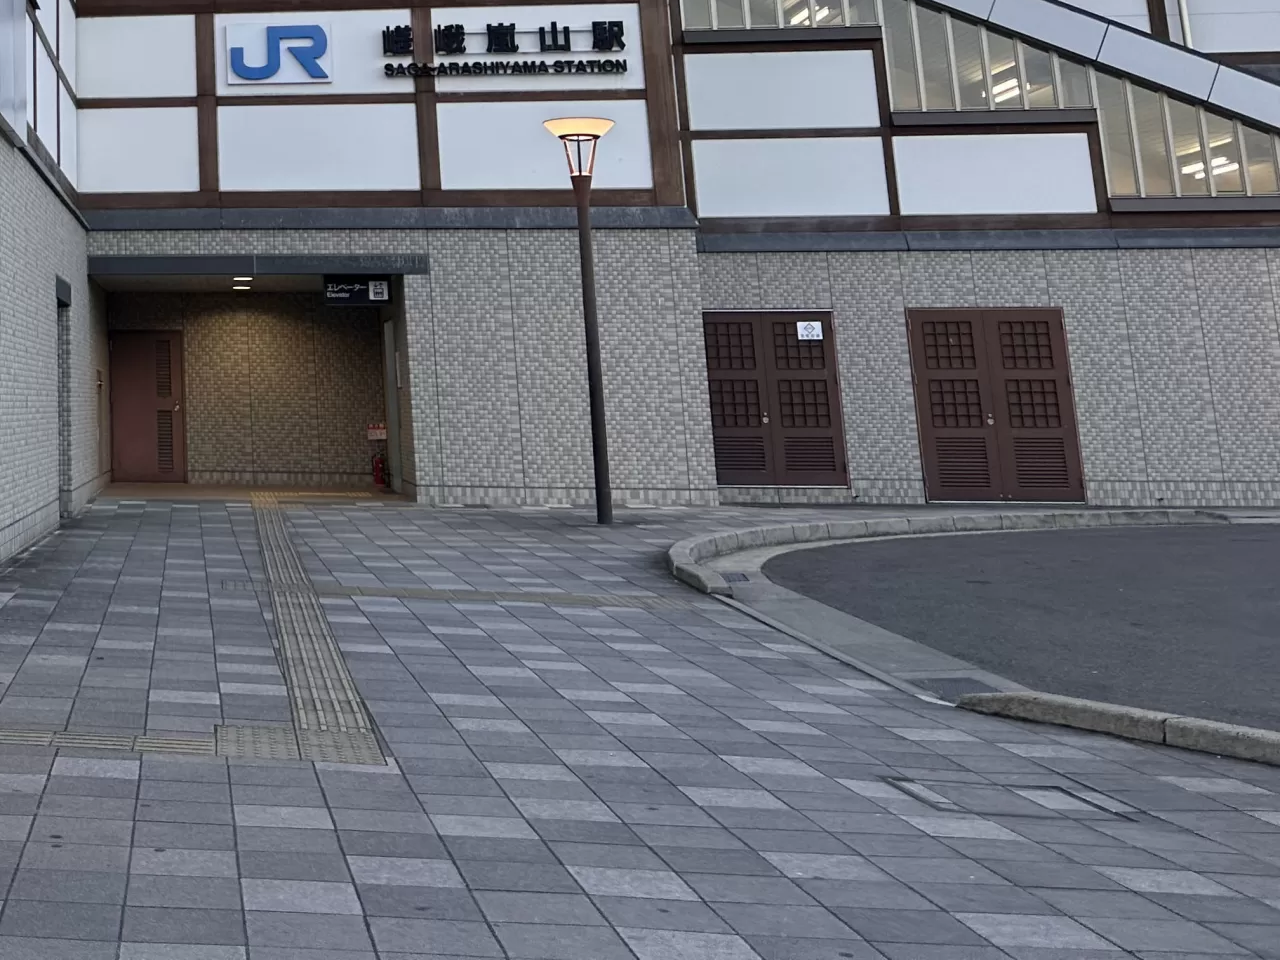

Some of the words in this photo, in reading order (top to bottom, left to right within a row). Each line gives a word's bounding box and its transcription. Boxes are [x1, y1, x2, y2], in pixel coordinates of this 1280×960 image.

[382, 21, 626, 55] 嵯峨嵐山駅
[230, 24, 329, 80] JR
[383, 61, 549, 77] SAGA-ARASHIYAMA
[552, 59, 628, 75] STATION
[327, 283, 367, 291] エレベーター
